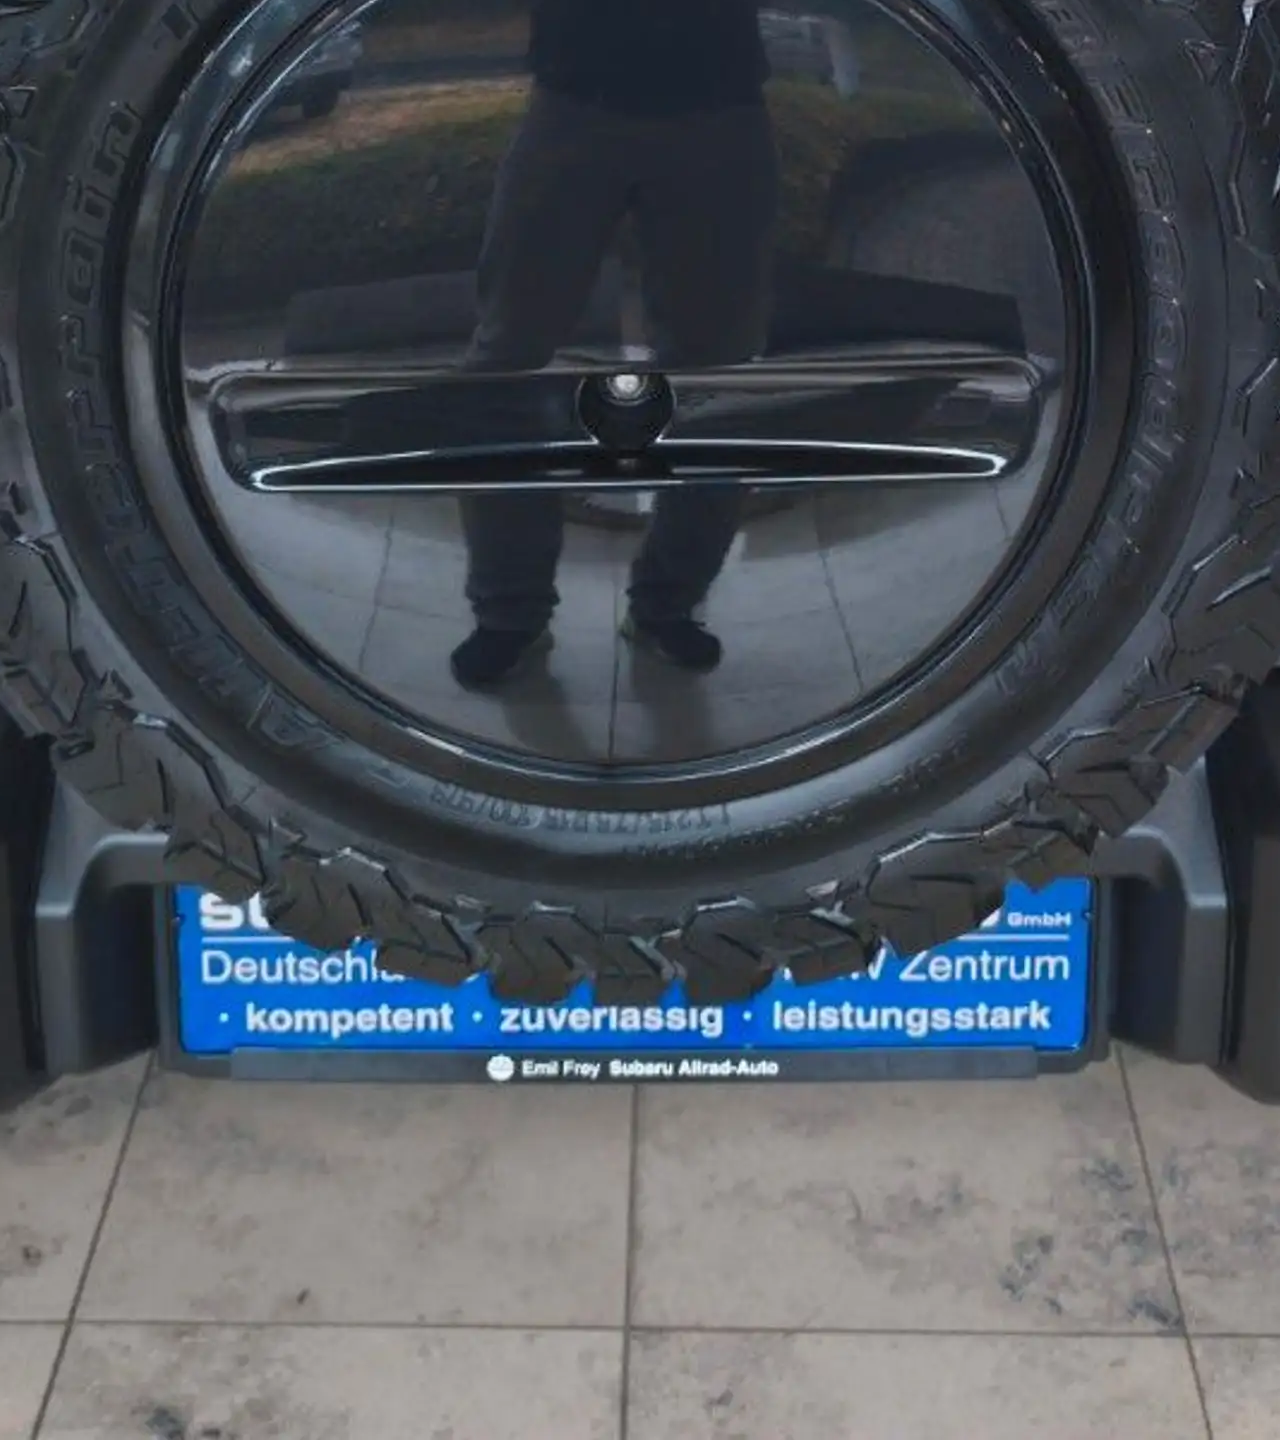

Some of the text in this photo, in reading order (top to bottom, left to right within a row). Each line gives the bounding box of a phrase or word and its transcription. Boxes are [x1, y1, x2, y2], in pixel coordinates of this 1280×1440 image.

[1007, 911, 1073, 928] GmbH
[201, 945, 407, 984] Deutschl
[899, 948, 1070, 983] Zentrum
[245, 1001, 455, 1039] kompetent
[772, 998, 1053, 1038] leistungsstark
[608, 1058, 672, 1077] Subaru
